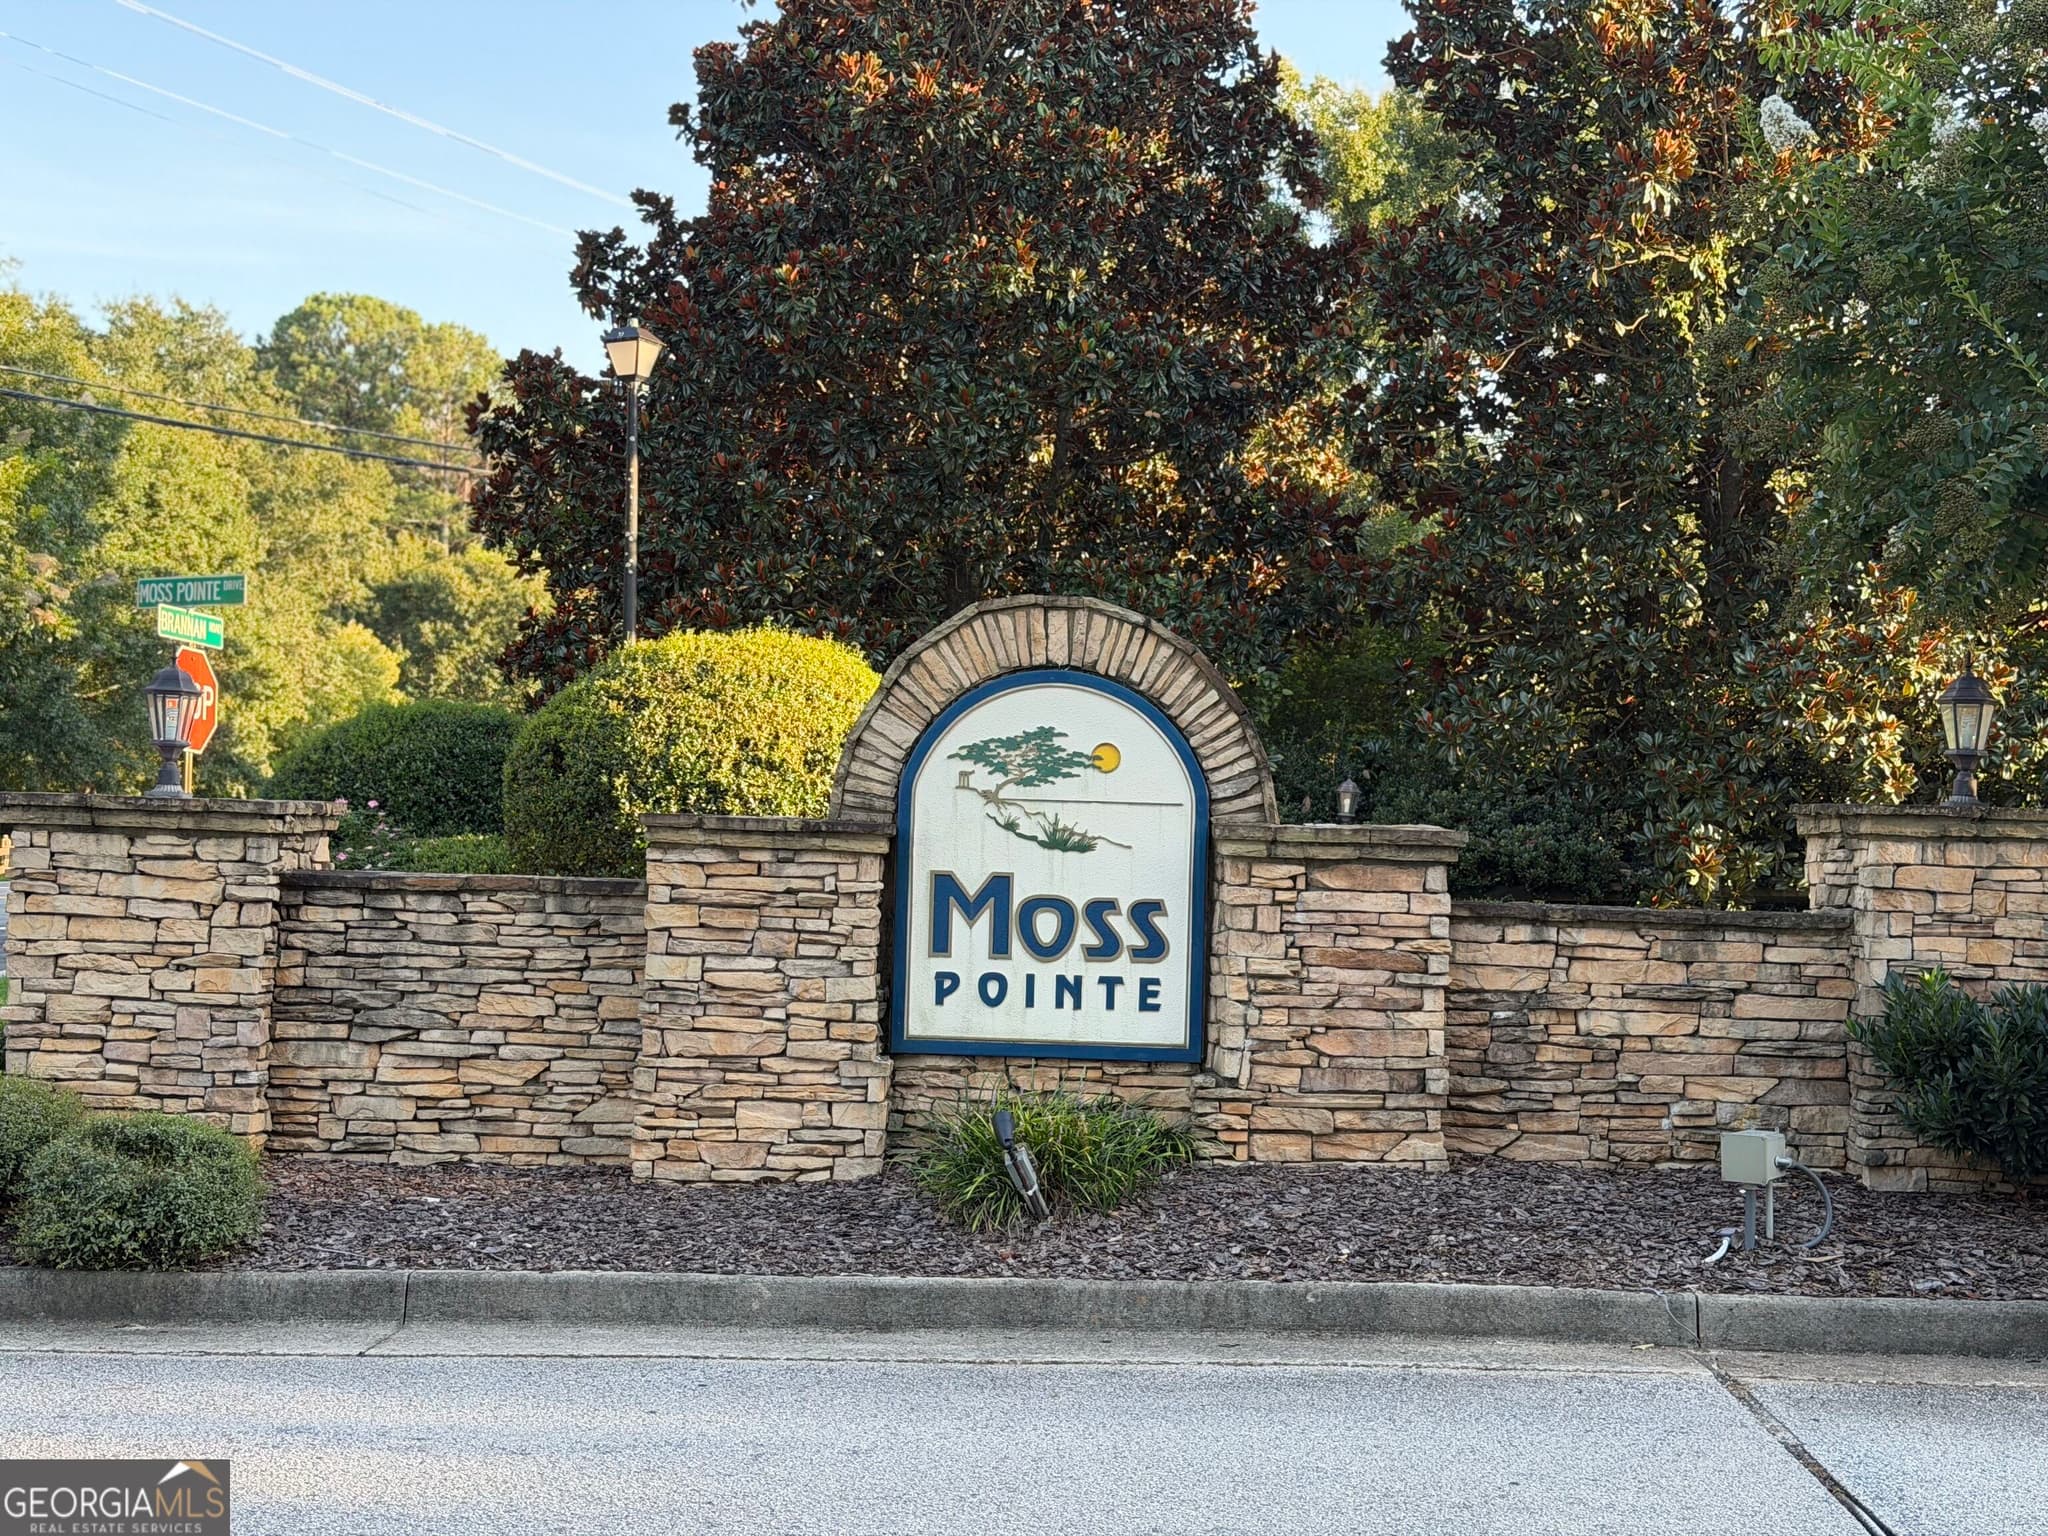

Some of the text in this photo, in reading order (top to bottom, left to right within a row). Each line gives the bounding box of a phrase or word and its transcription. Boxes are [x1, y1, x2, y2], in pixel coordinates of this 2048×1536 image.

[140, 583, 173, 603] MOSS
[177, 581, 221, 601] POINTE
[161, 612, 206, 640] BRANNAN
[934, 971, 1162, 1012] POINTE
